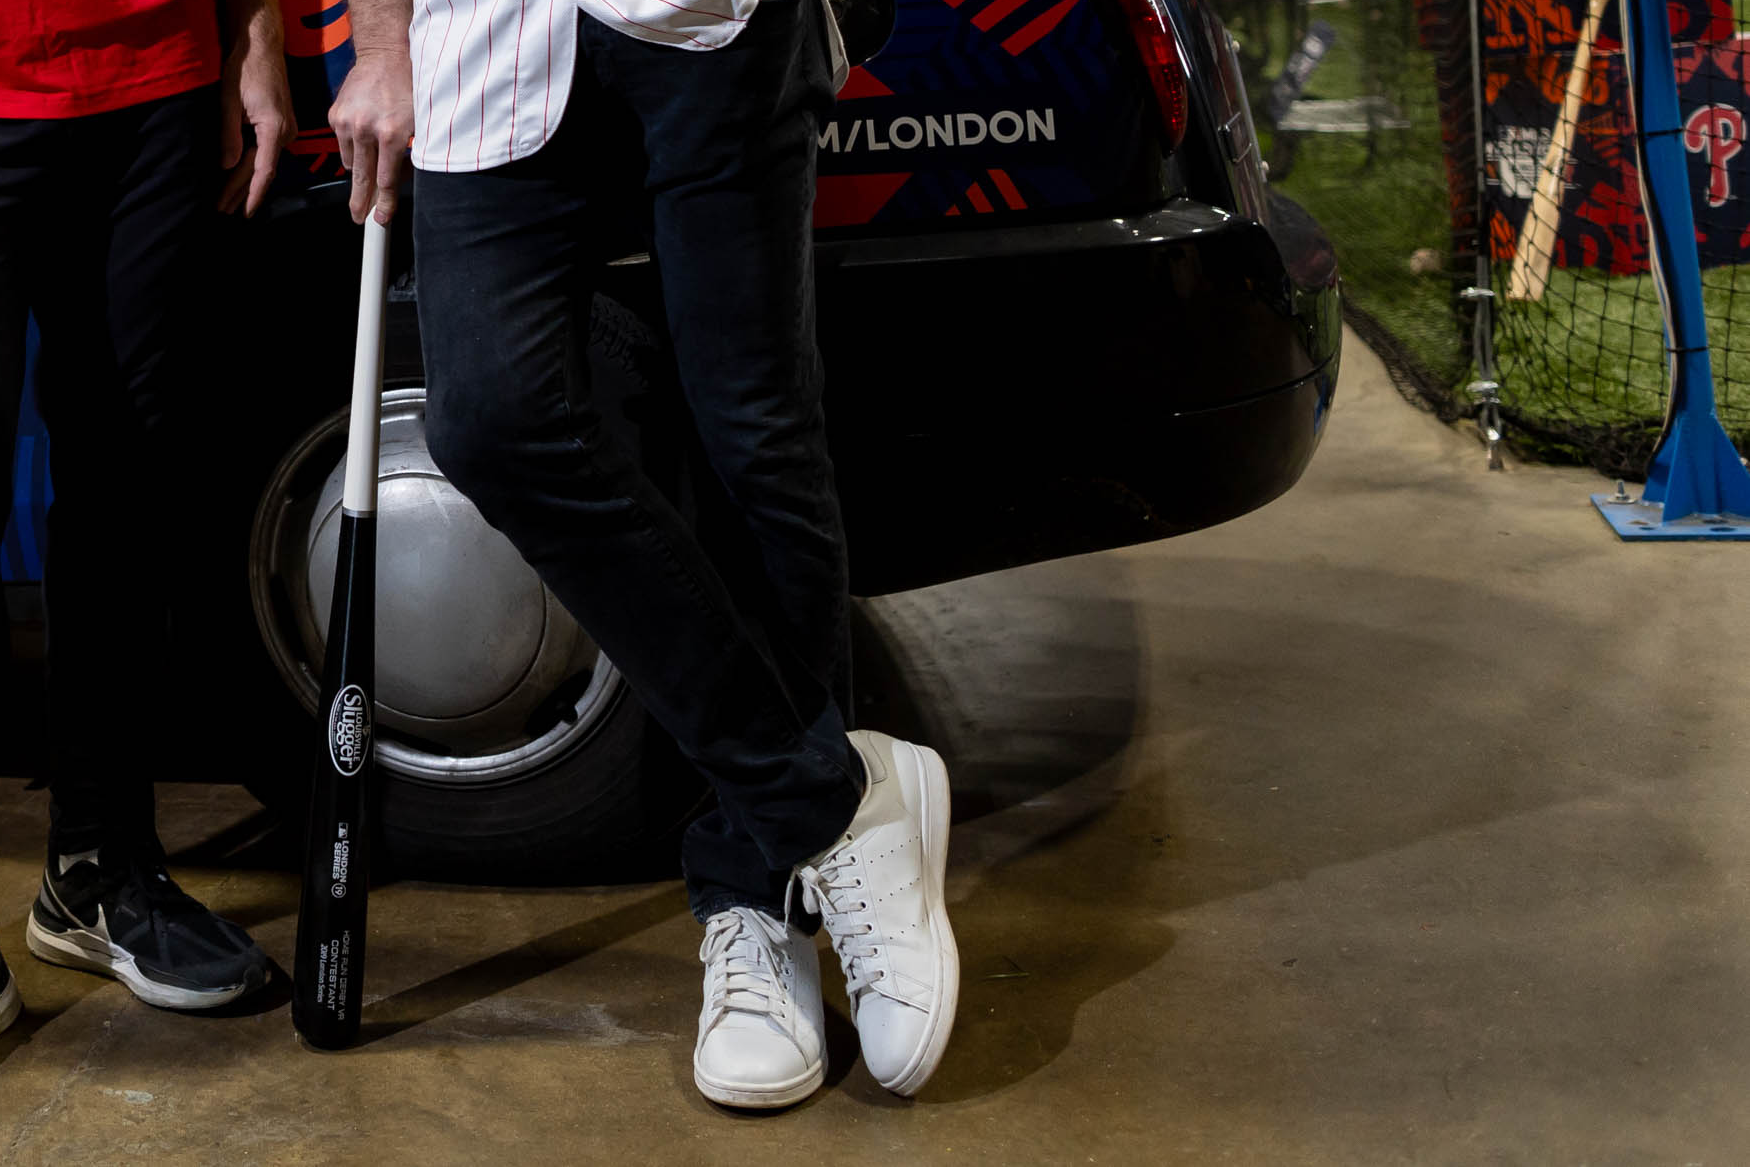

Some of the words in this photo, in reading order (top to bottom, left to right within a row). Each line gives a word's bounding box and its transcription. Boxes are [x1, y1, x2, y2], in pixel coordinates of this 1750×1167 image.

[336, 694, 363, 762] Slugger
[353, 712, 363, 762] LOUISVILLE
[332, 841, 342, 880] SERIES
[339, 840, 350, 883] LONDON
[327, 939, 340, 1011] CONTESTANT
